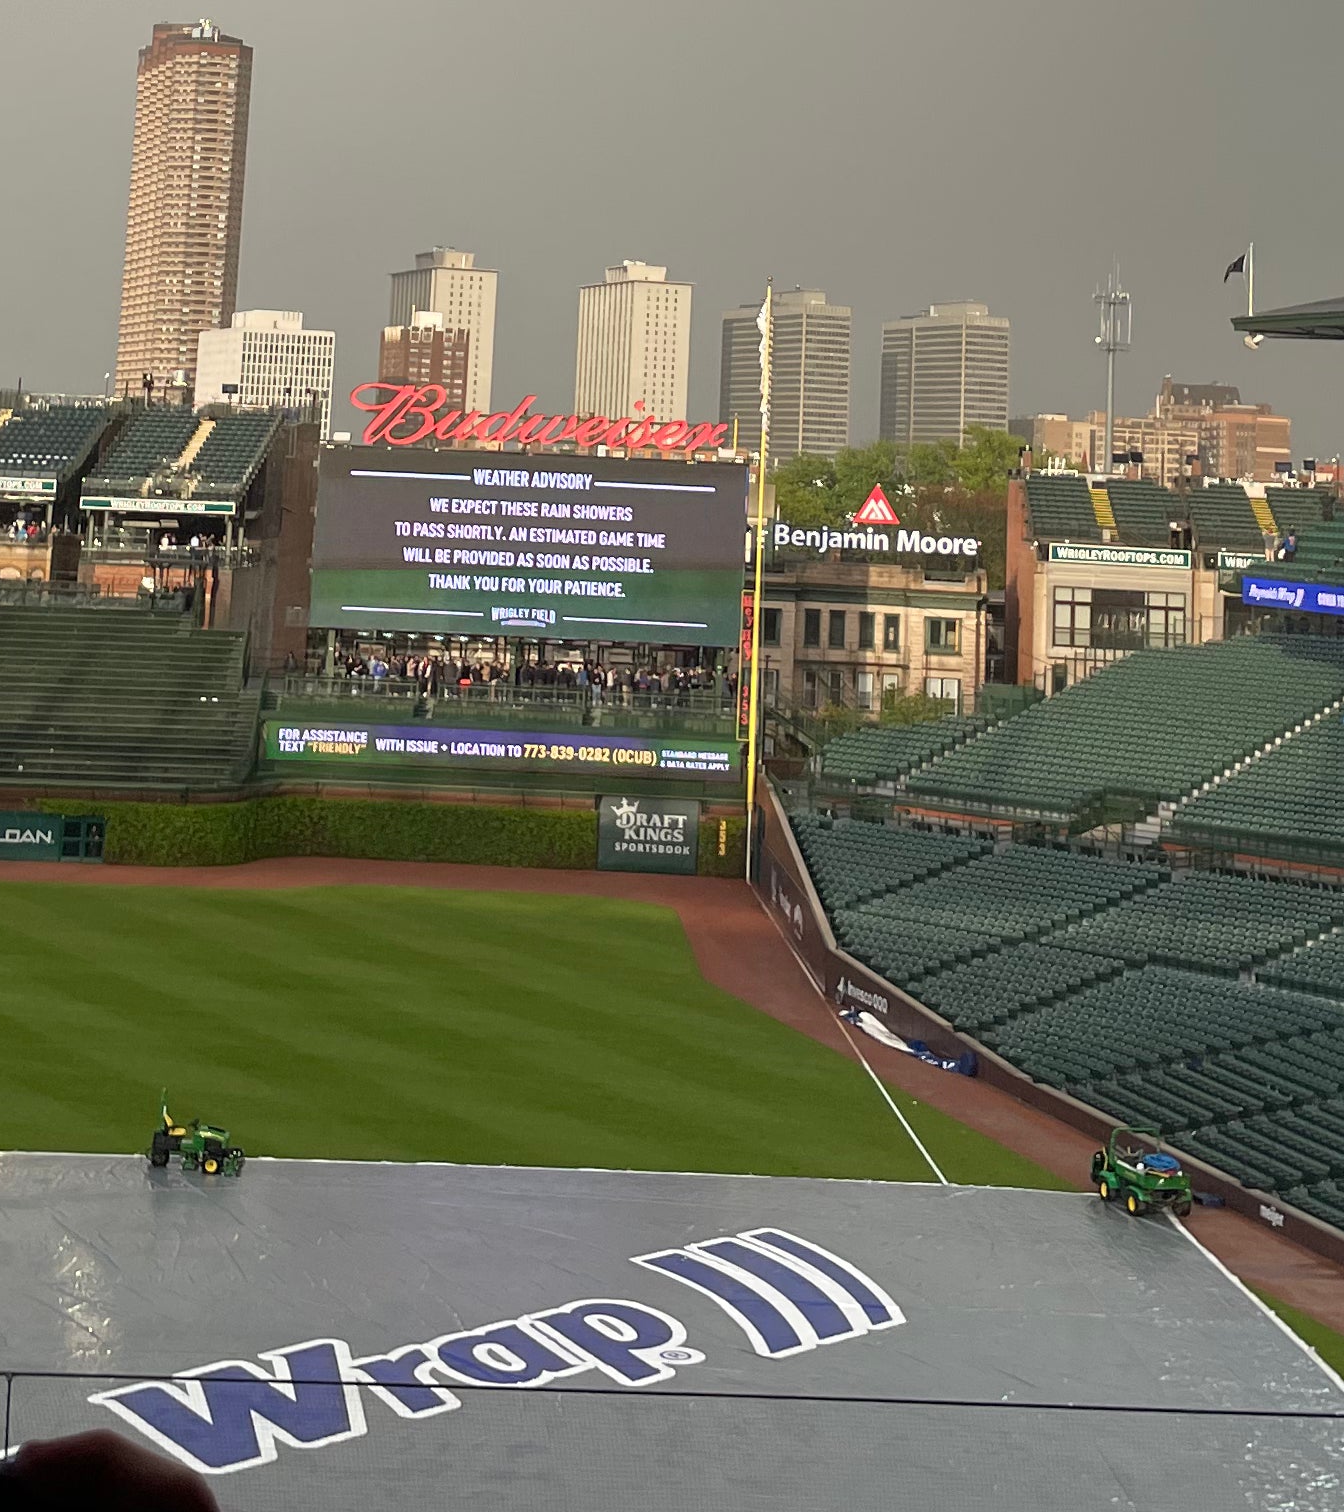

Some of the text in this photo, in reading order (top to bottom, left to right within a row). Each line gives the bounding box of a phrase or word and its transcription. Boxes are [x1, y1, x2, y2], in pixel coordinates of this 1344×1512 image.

[350, 382, 729, 450] Budweiser
[473, 468, 593, 491] WEATHER ADVISORY
[430, 498, 633, 522] WE EXPECT THESE RAIN SHOWERS
[395, 522, 666, 549] TO PASS SHORTLY. AN ESTIMATED GAME TIME
[774, 523, 978, 555] Benjamin Moore
[403, 546, 654, 573] WILL BE PROVIDED AS SOON AS POSSIBLE.
[1057, 546, 1184, 565] WRIGLEYROOFTOPS.COM
[428, 573, 626, 598] THANK YOU FOR YOUR PATIENCE.
[491, 606, 556, 624] WRIGLEY FIELD
[279, 728, 368, 744] FOR ASSISTANCE
[279, 740, 305, 752] TEXT
[375, 738, 404, 752] WITH
[406, 740, 438, 754] ISSUE
[451, 742, 505, 757] LOCATION
[507, 745, 522, 758] TO
[523, 744, 610, 762] 773-839-0282
[667, 760, 684, 768] DATA
[708, 762, 729, 771] APPLY
[615, 811, 687, 829] DRAFT
[623, 827, 684, 842] KINGS
[615, 841, 690, 855] SPORTSBOOK
[89, 1298, 688, 1474] Wrap
